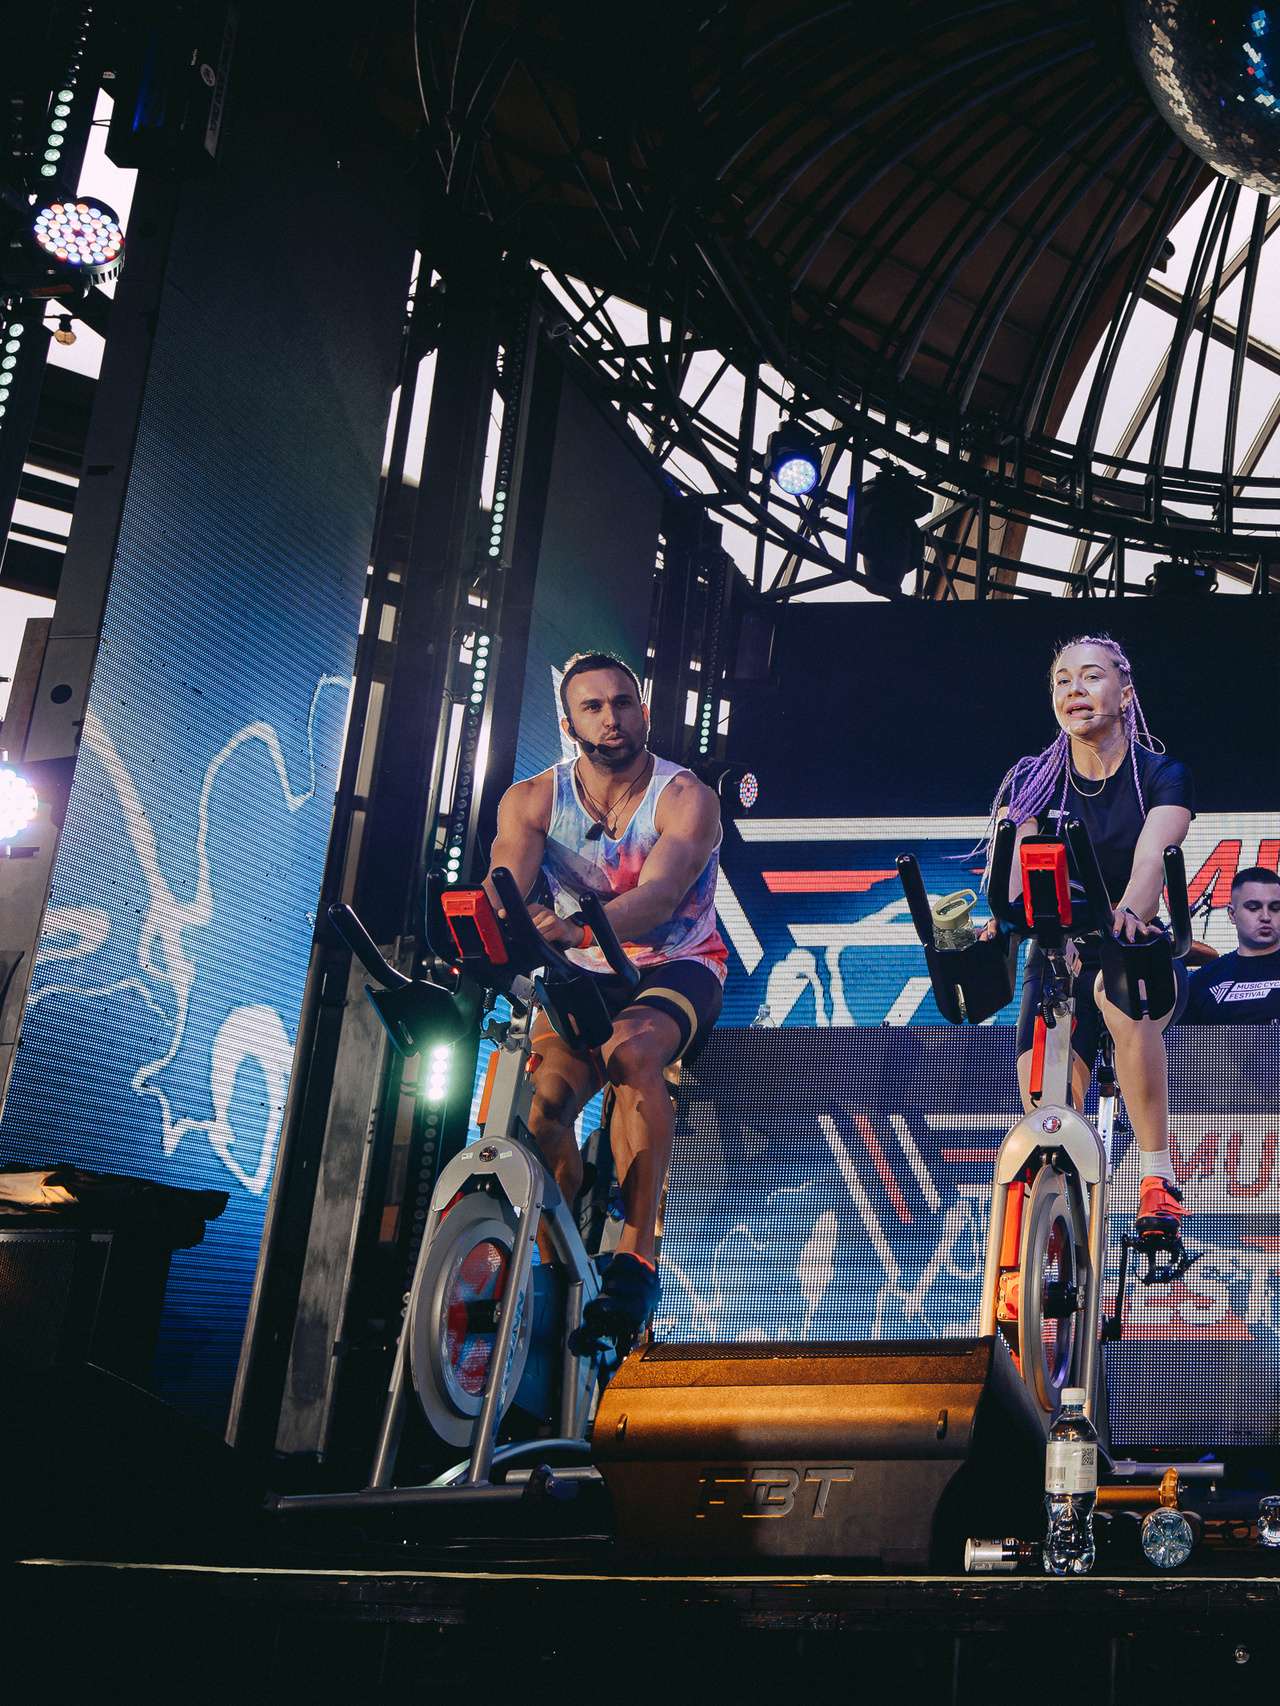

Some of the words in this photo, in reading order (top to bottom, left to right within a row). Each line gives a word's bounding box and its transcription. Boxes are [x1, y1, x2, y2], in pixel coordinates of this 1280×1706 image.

[1236, 982, 1263, 991] MUSIC
[1228, 990, 1267, 1000] FESTIVAL
[696, 1467, 854, 1518] FBT
